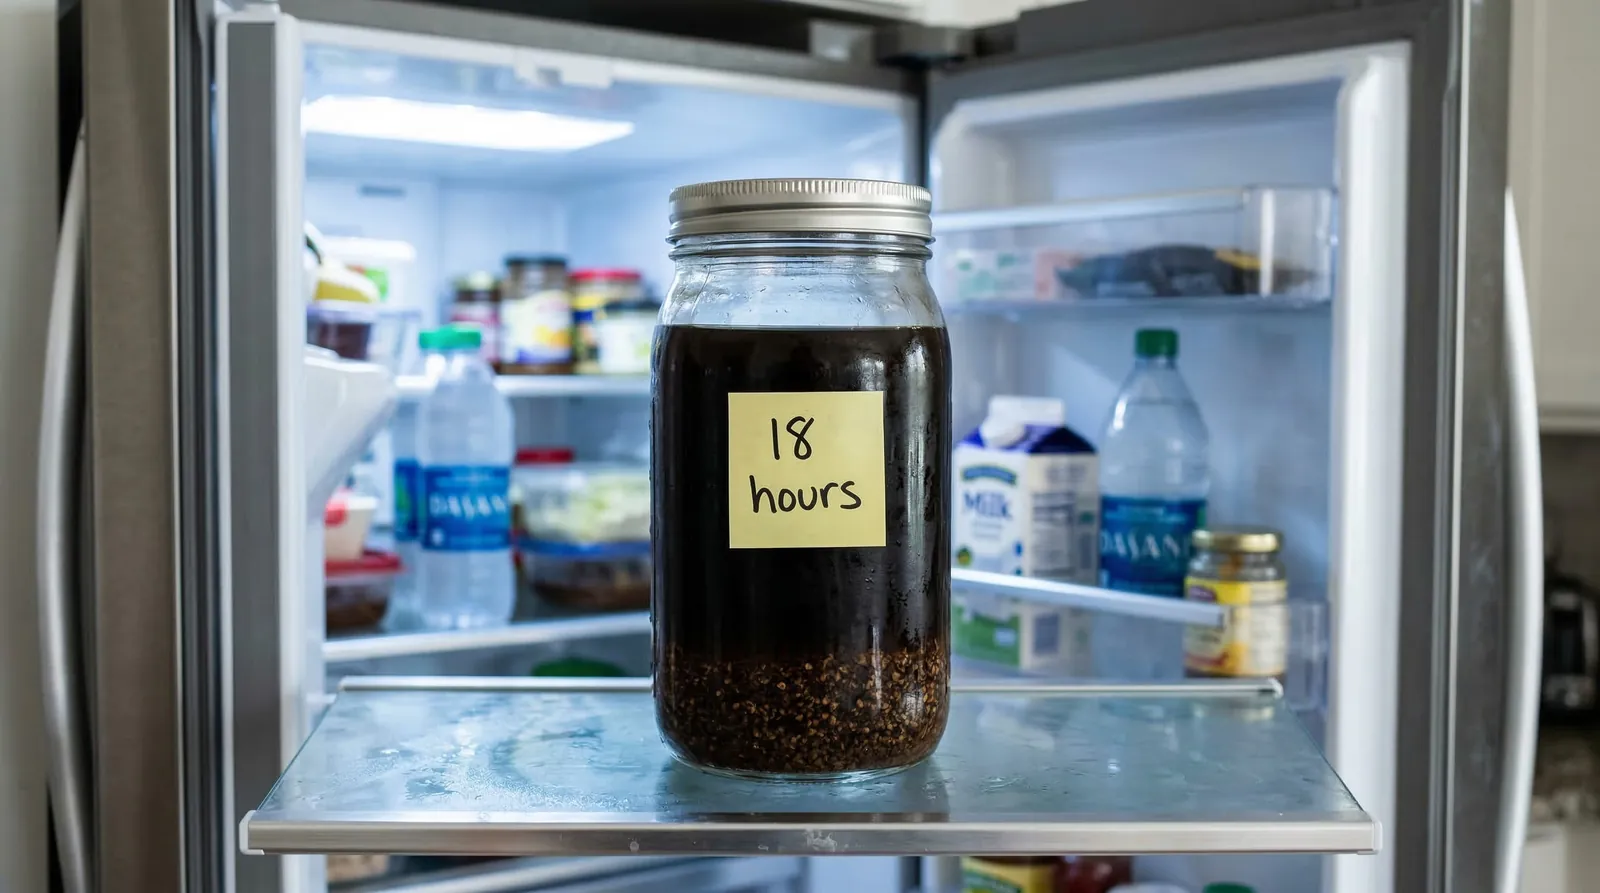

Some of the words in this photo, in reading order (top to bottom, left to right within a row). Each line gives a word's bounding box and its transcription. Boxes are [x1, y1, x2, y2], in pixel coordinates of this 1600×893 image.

[771, 416, 814, 460] 18
[749, 474, 862, 514] hours
[962, 491, 1013, 520] Milk
